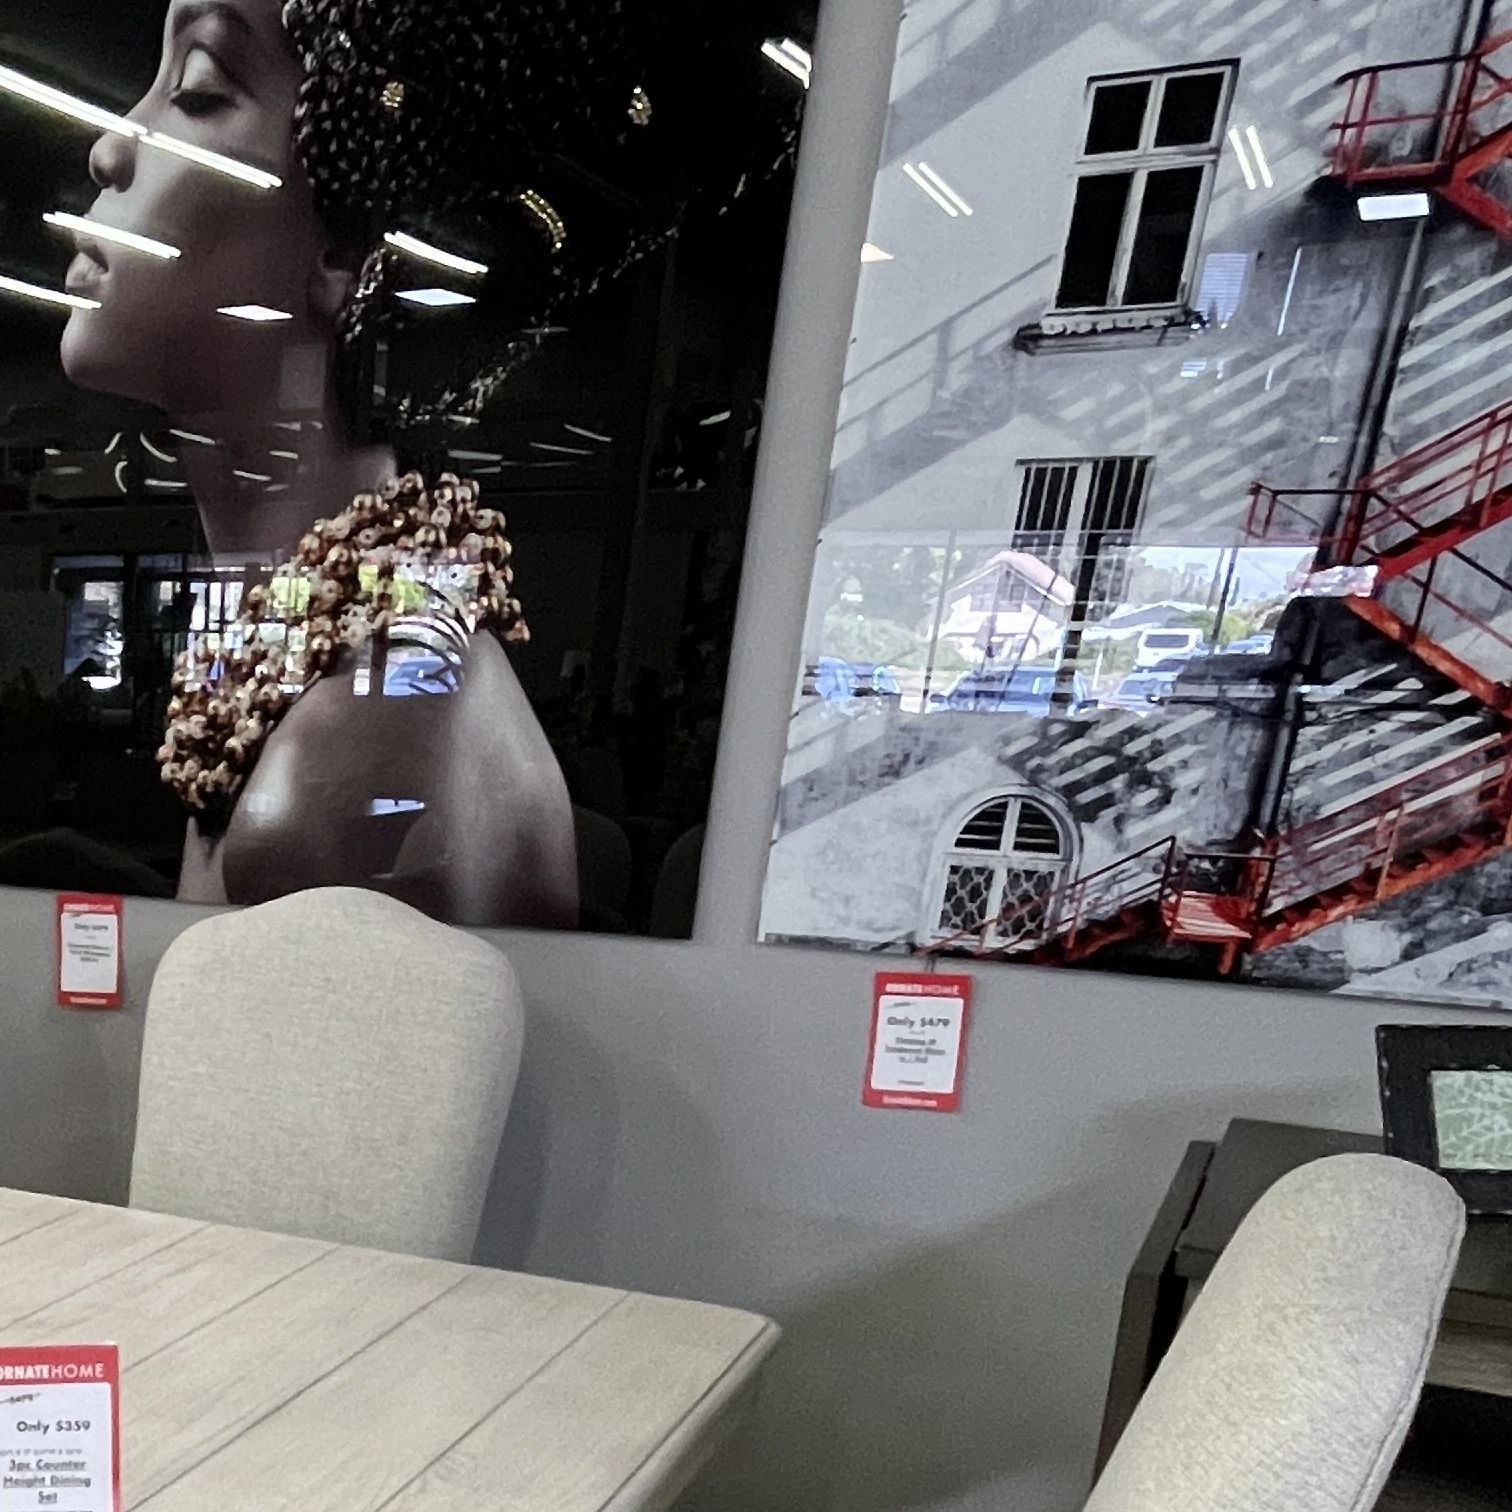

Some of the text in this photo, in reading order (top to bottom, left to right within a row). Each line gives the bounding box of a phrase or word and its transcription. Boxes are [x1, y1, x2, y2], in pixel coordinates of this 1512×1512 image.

[886, 1015, 916, 1029] Only
[16, 1419, 92, 1435] Only $359
[35, 1458, 87, 1471] Counter
[50, 1474, 92, 1488] Dining
